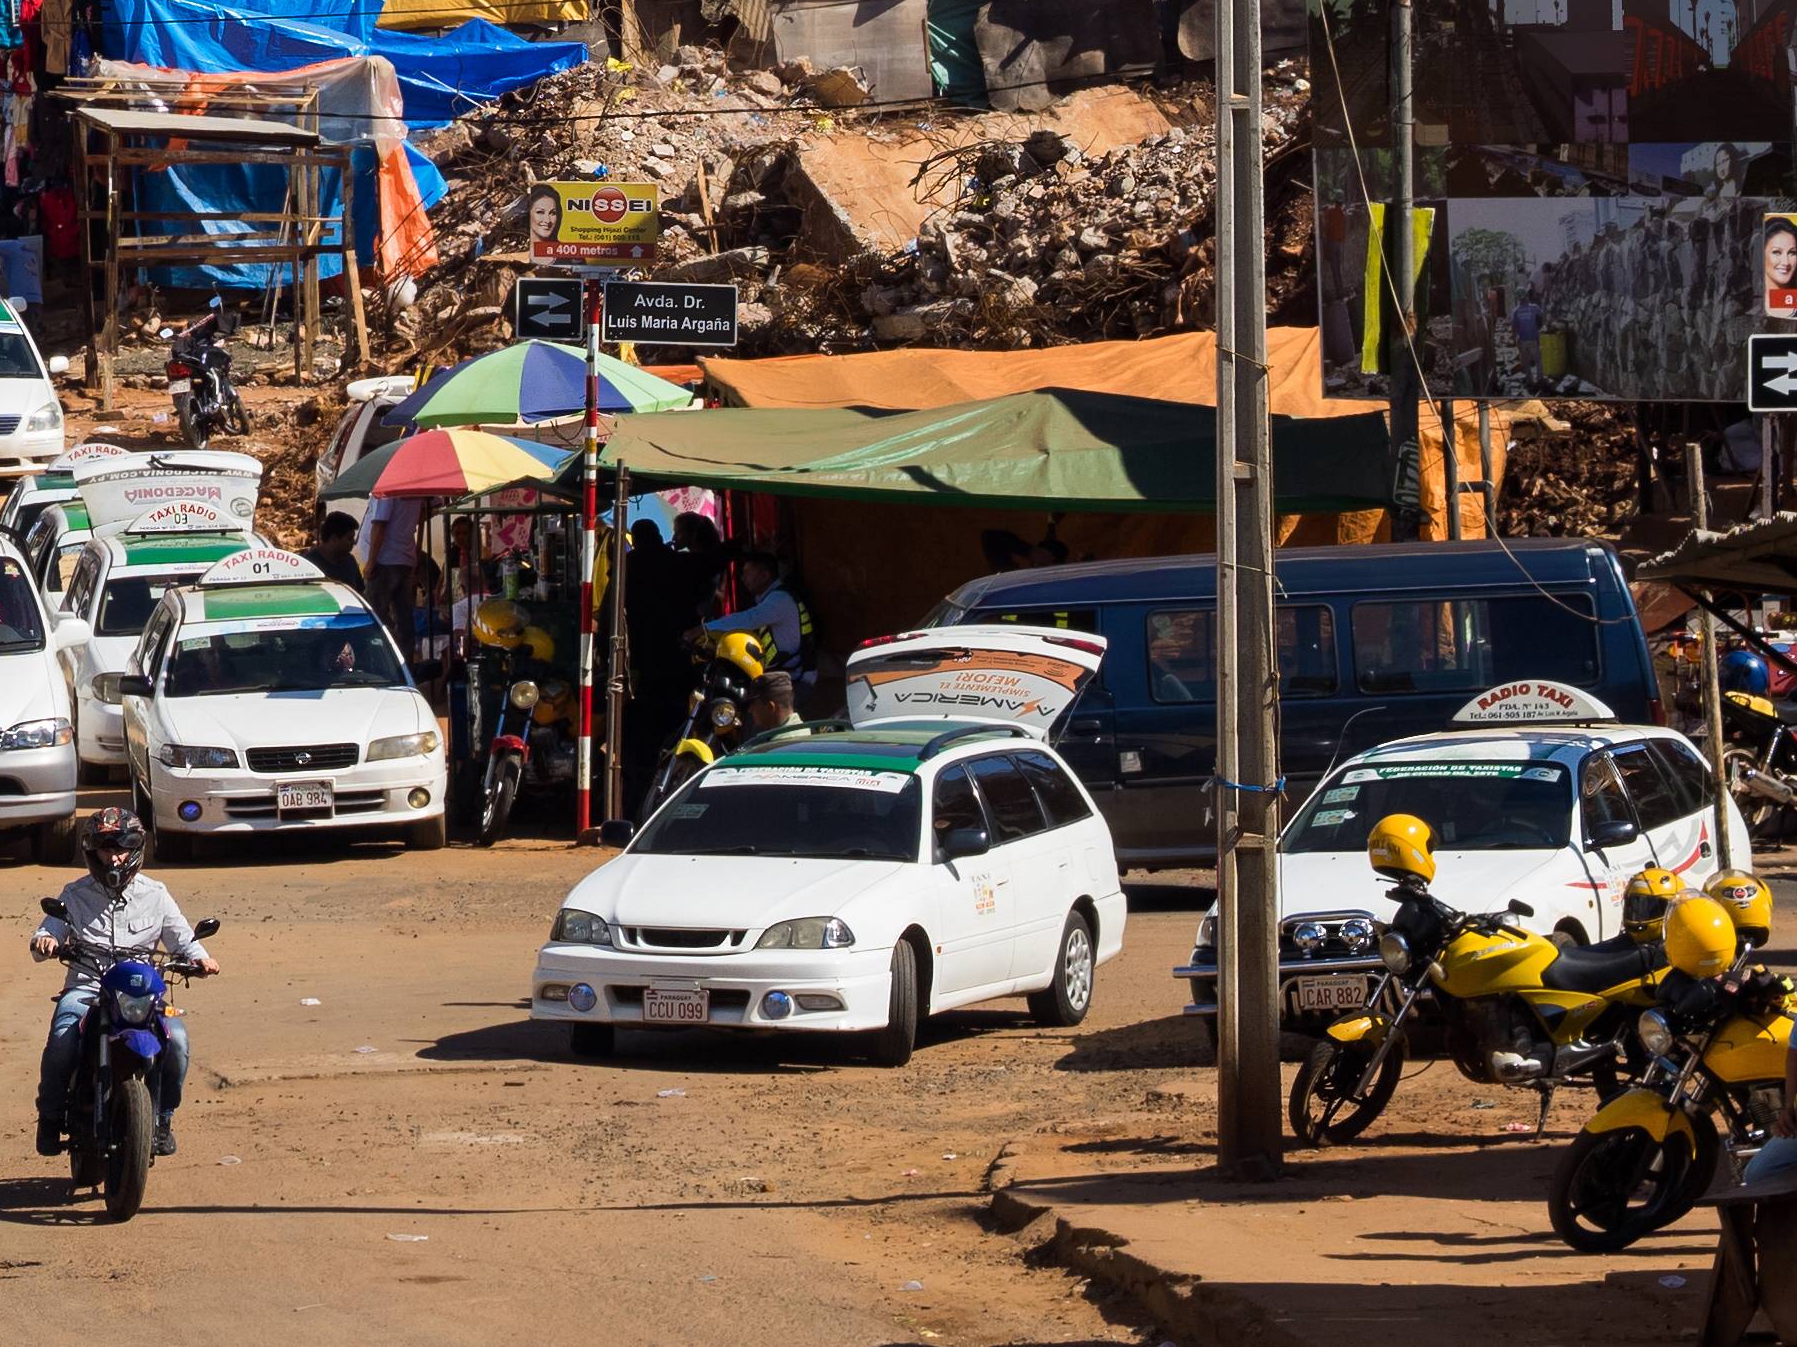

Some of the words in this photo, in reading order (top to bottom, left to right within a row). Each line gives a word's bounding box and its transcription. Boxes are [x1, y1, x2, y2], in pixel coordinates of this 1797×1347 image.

[567, 198, 652, 212] NISSEI
[546, 246, 554, 255] a
[556, 244, 577, 256] 400
[580, 245, 618, 256] metros
[634, 293, 679, 309] Avda.
[684, 295, 705, 309] Dr.
[608, 314, 637, 329] Luis
[641, 314, 678, 330] Maria
[681, 316, 731, 334] Argaña
[148, 506, 176, 523] TAXI
[180, 503, 217, 521] RADIO
[223, 550, 253, 570] TAXI
[257, 550, 300, 567] RADIO
[252, 562, 270, 574] 01
[1477, 683, 1531, 711] RADIO
[1537, 684, 1575, 710] TAXI
[306, 791, 327, 806] 984
[1306, 987, 1333, 1007] CAR
[1336, 987, 1362, 1004] 882
[650, 1002, 674, 1018] CCU
[678, 1002, 703, 1019] 099
